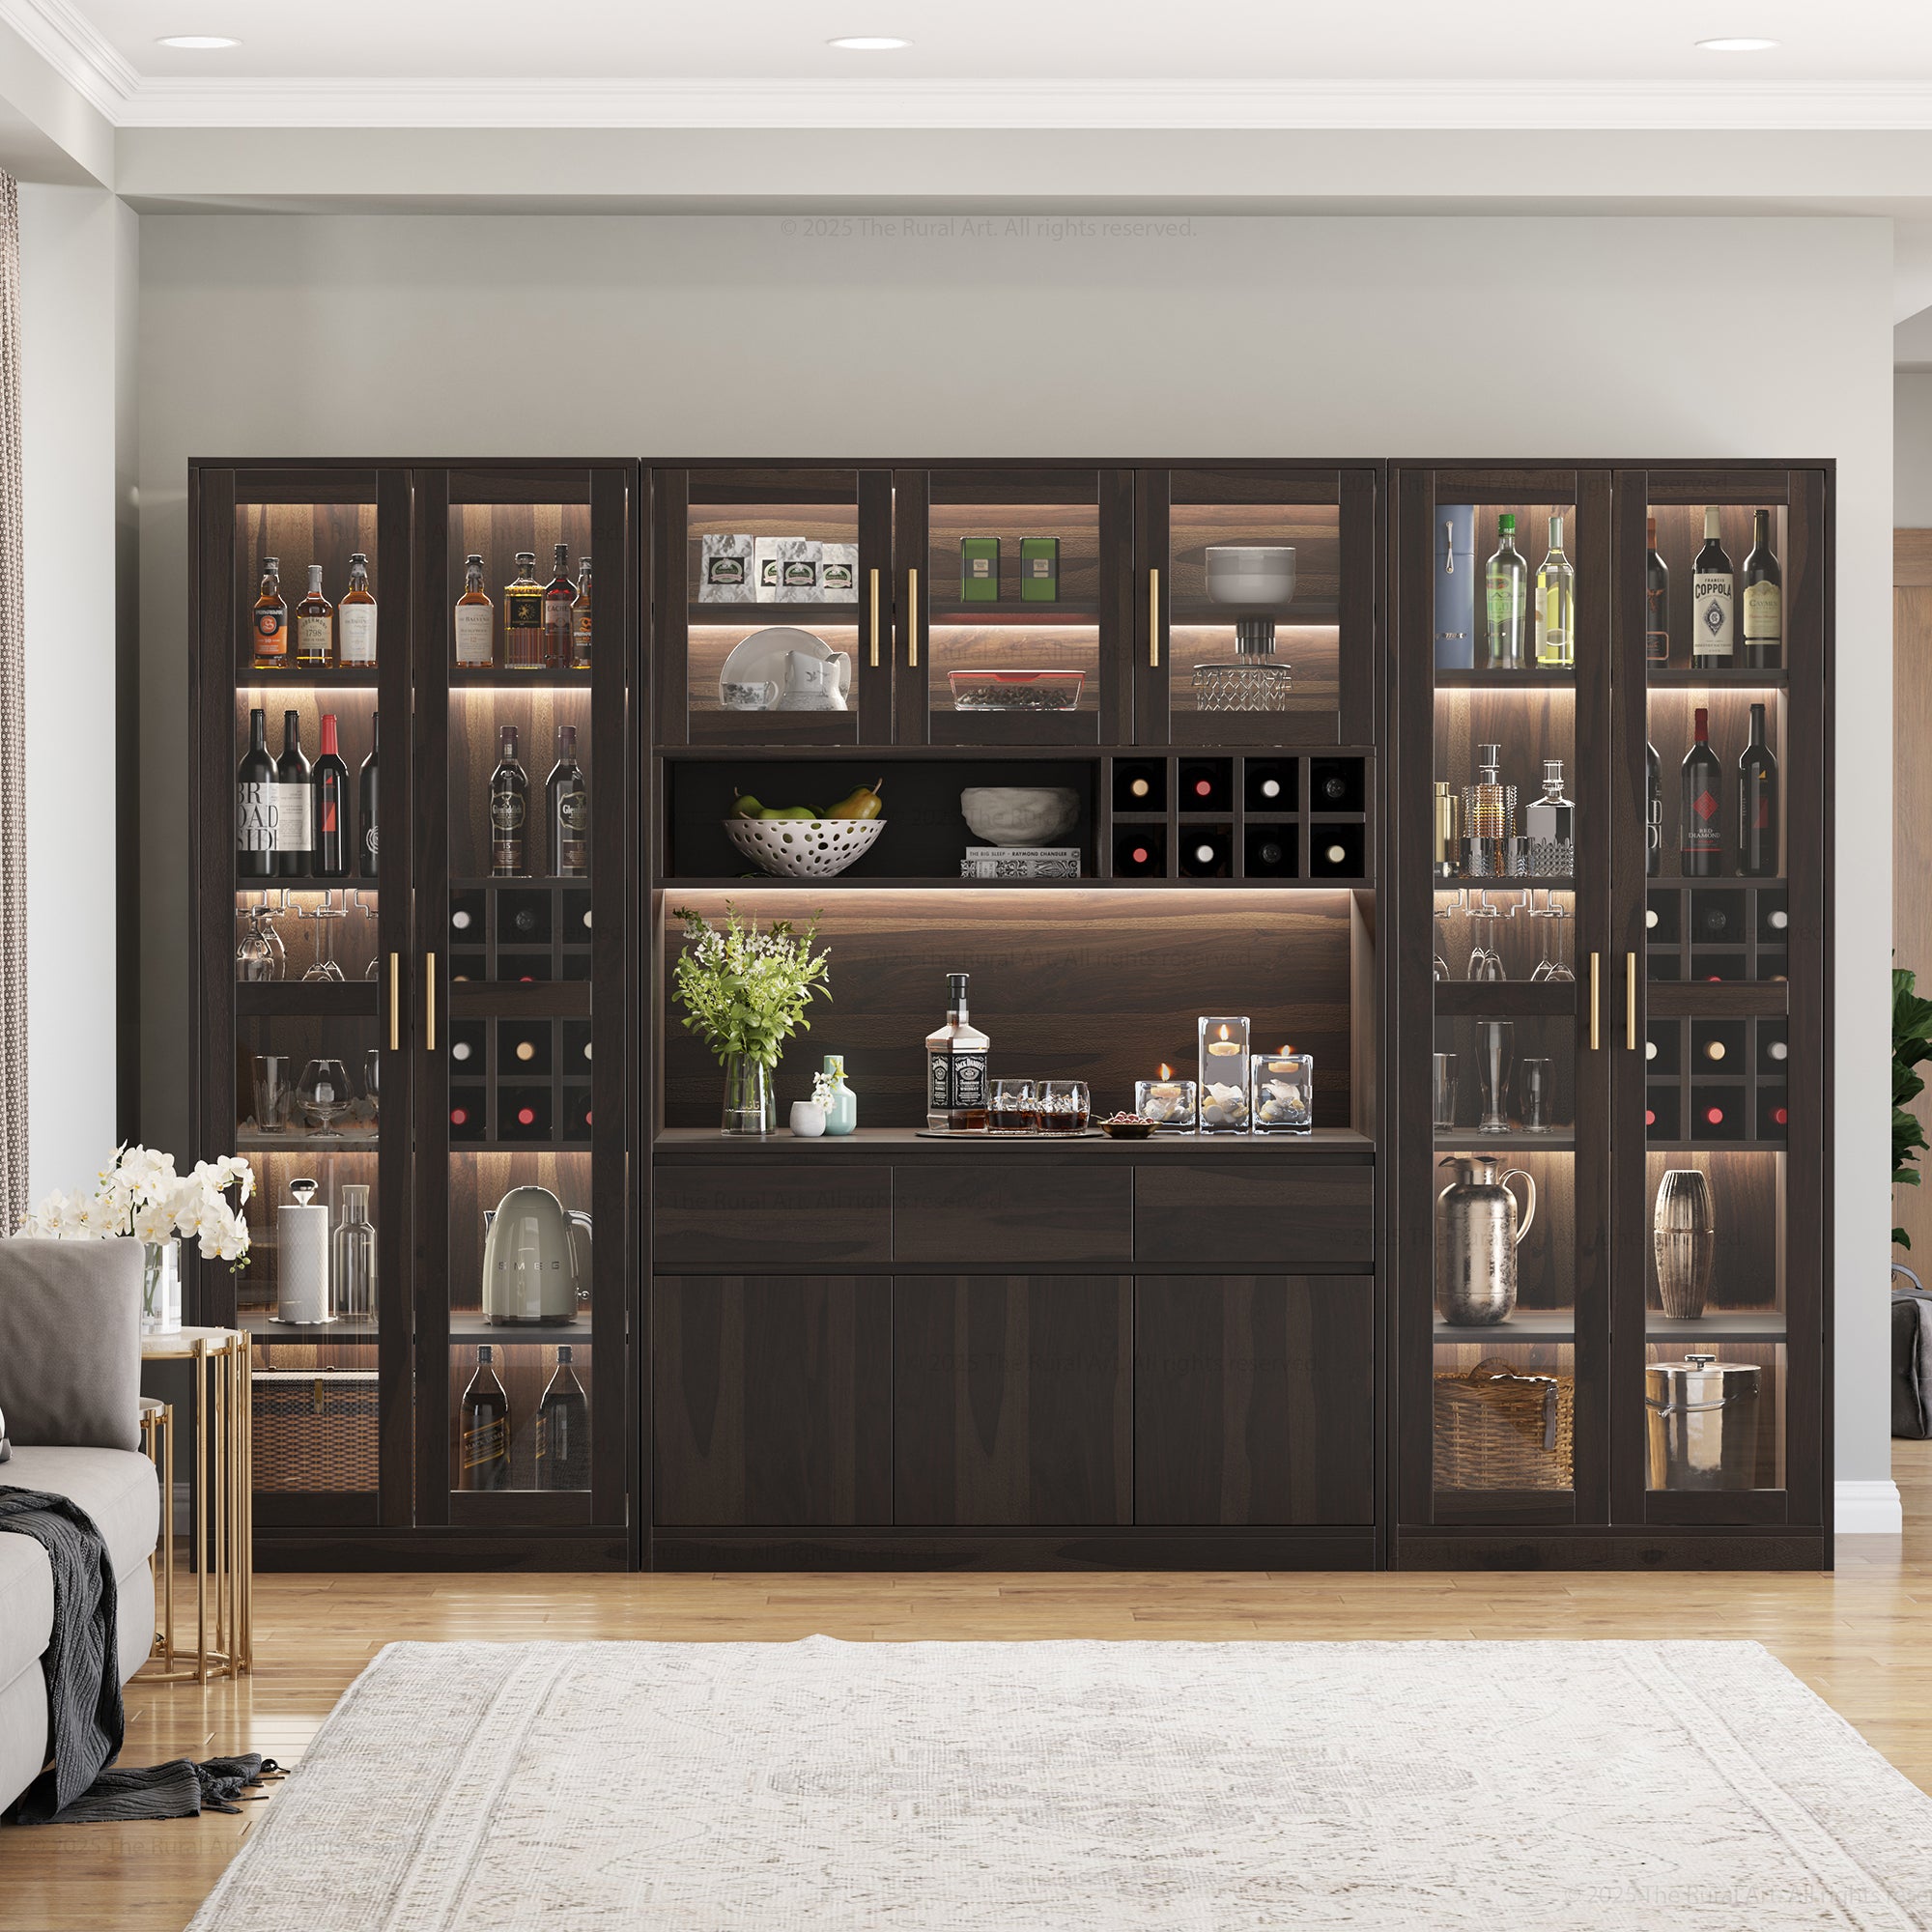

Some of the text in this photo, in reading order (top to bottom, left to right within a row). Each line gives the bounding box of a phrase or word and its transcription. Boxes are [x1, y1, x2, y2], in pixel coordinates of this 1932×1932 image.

[1694, 582, 1732, 599] COPPOLA
[305, 629, 323, 638] 1798
[955, 1060, 967, 1071] JACK
[498, 1261, 560, 1270] SMEG
